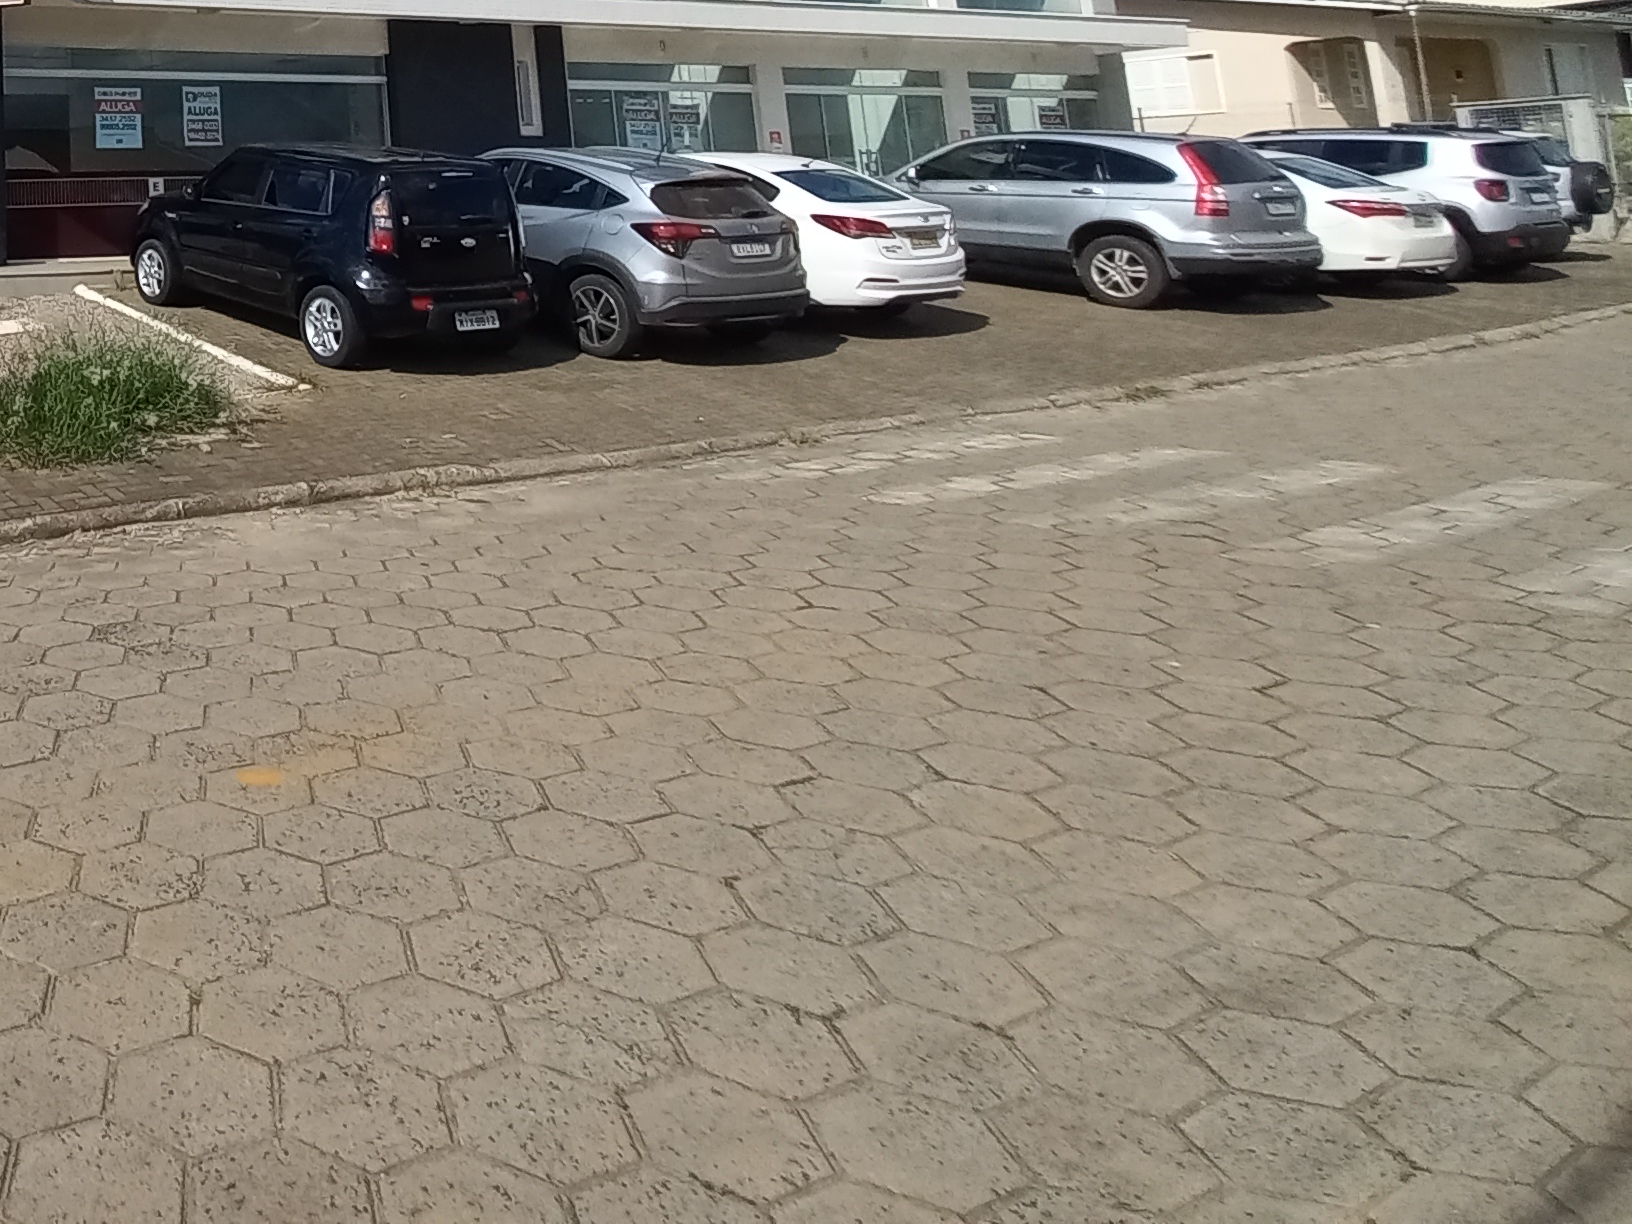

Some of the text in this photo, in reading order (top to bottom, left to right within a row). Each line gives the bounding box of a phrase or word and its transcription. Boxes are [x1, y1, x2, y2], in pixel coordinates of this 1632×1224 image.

[99, 101, 136, 112] ALUGA
[187, 106, 219, 116] ALUGA
[152, 181, 161, 192] E
